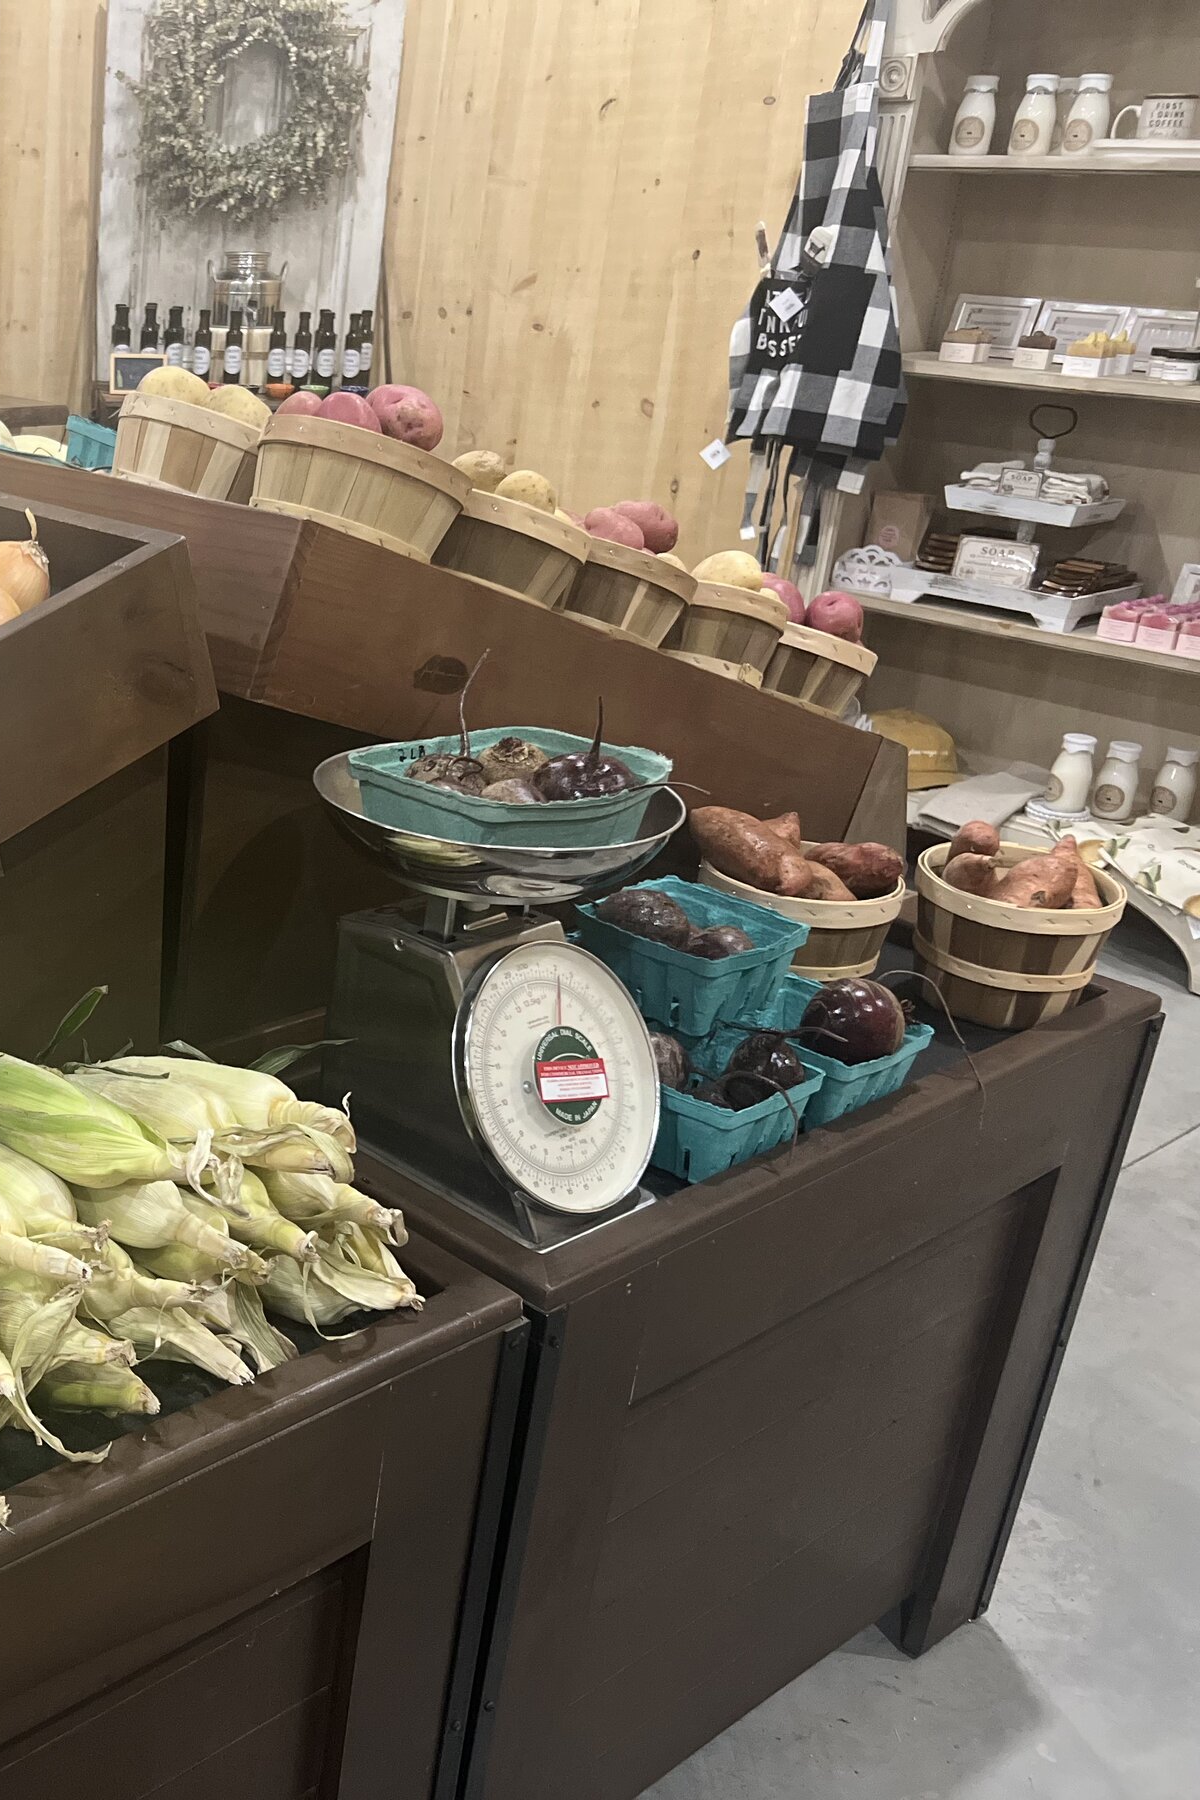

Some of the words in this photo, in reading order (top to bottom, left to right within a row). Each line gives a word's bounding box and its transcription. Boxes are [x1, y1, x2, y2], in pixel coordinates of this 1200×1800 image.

[1155, 102, 1183, 110] FIRST
[1149, 119, 1183, 127] COFFEE
[1010, 474, 1034, 482] SOAP
[980, 546, 1016, 557] SOAP
[537, 1031, 559, 1060] UNIVERSAL
[559, 1028, 573, 1037] DIAL
[574, 1032, 593, 1052] SCALE
[555, 1107, 573, 1121] MADE
[574, 1113, 581, 1121] IN
[582, 1101, 598, 1119] JAPAN
